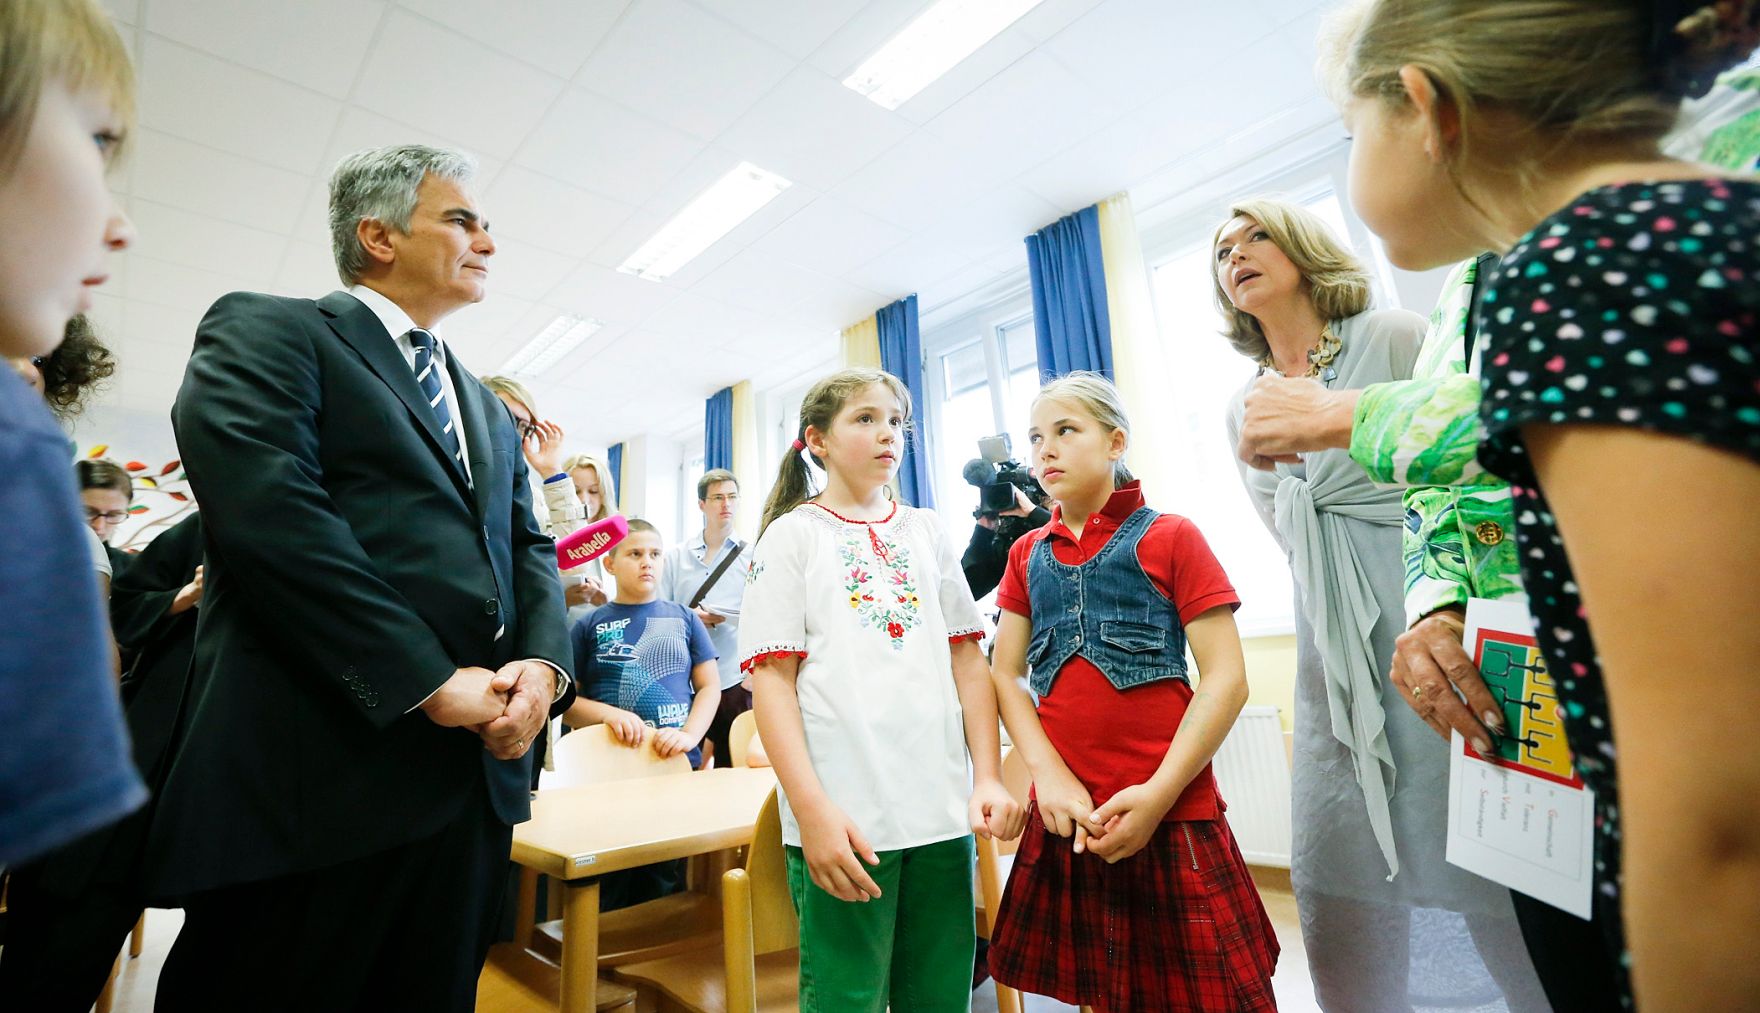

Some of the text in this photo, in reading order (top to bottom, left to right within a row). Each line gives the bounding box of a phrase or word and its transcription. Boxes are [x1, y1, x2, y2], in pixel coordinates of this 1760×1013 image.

[566, 532, 611, 560] Arabella
[596, 617, 631, 634] SURF
[597, 629, 623, 644] PRO
